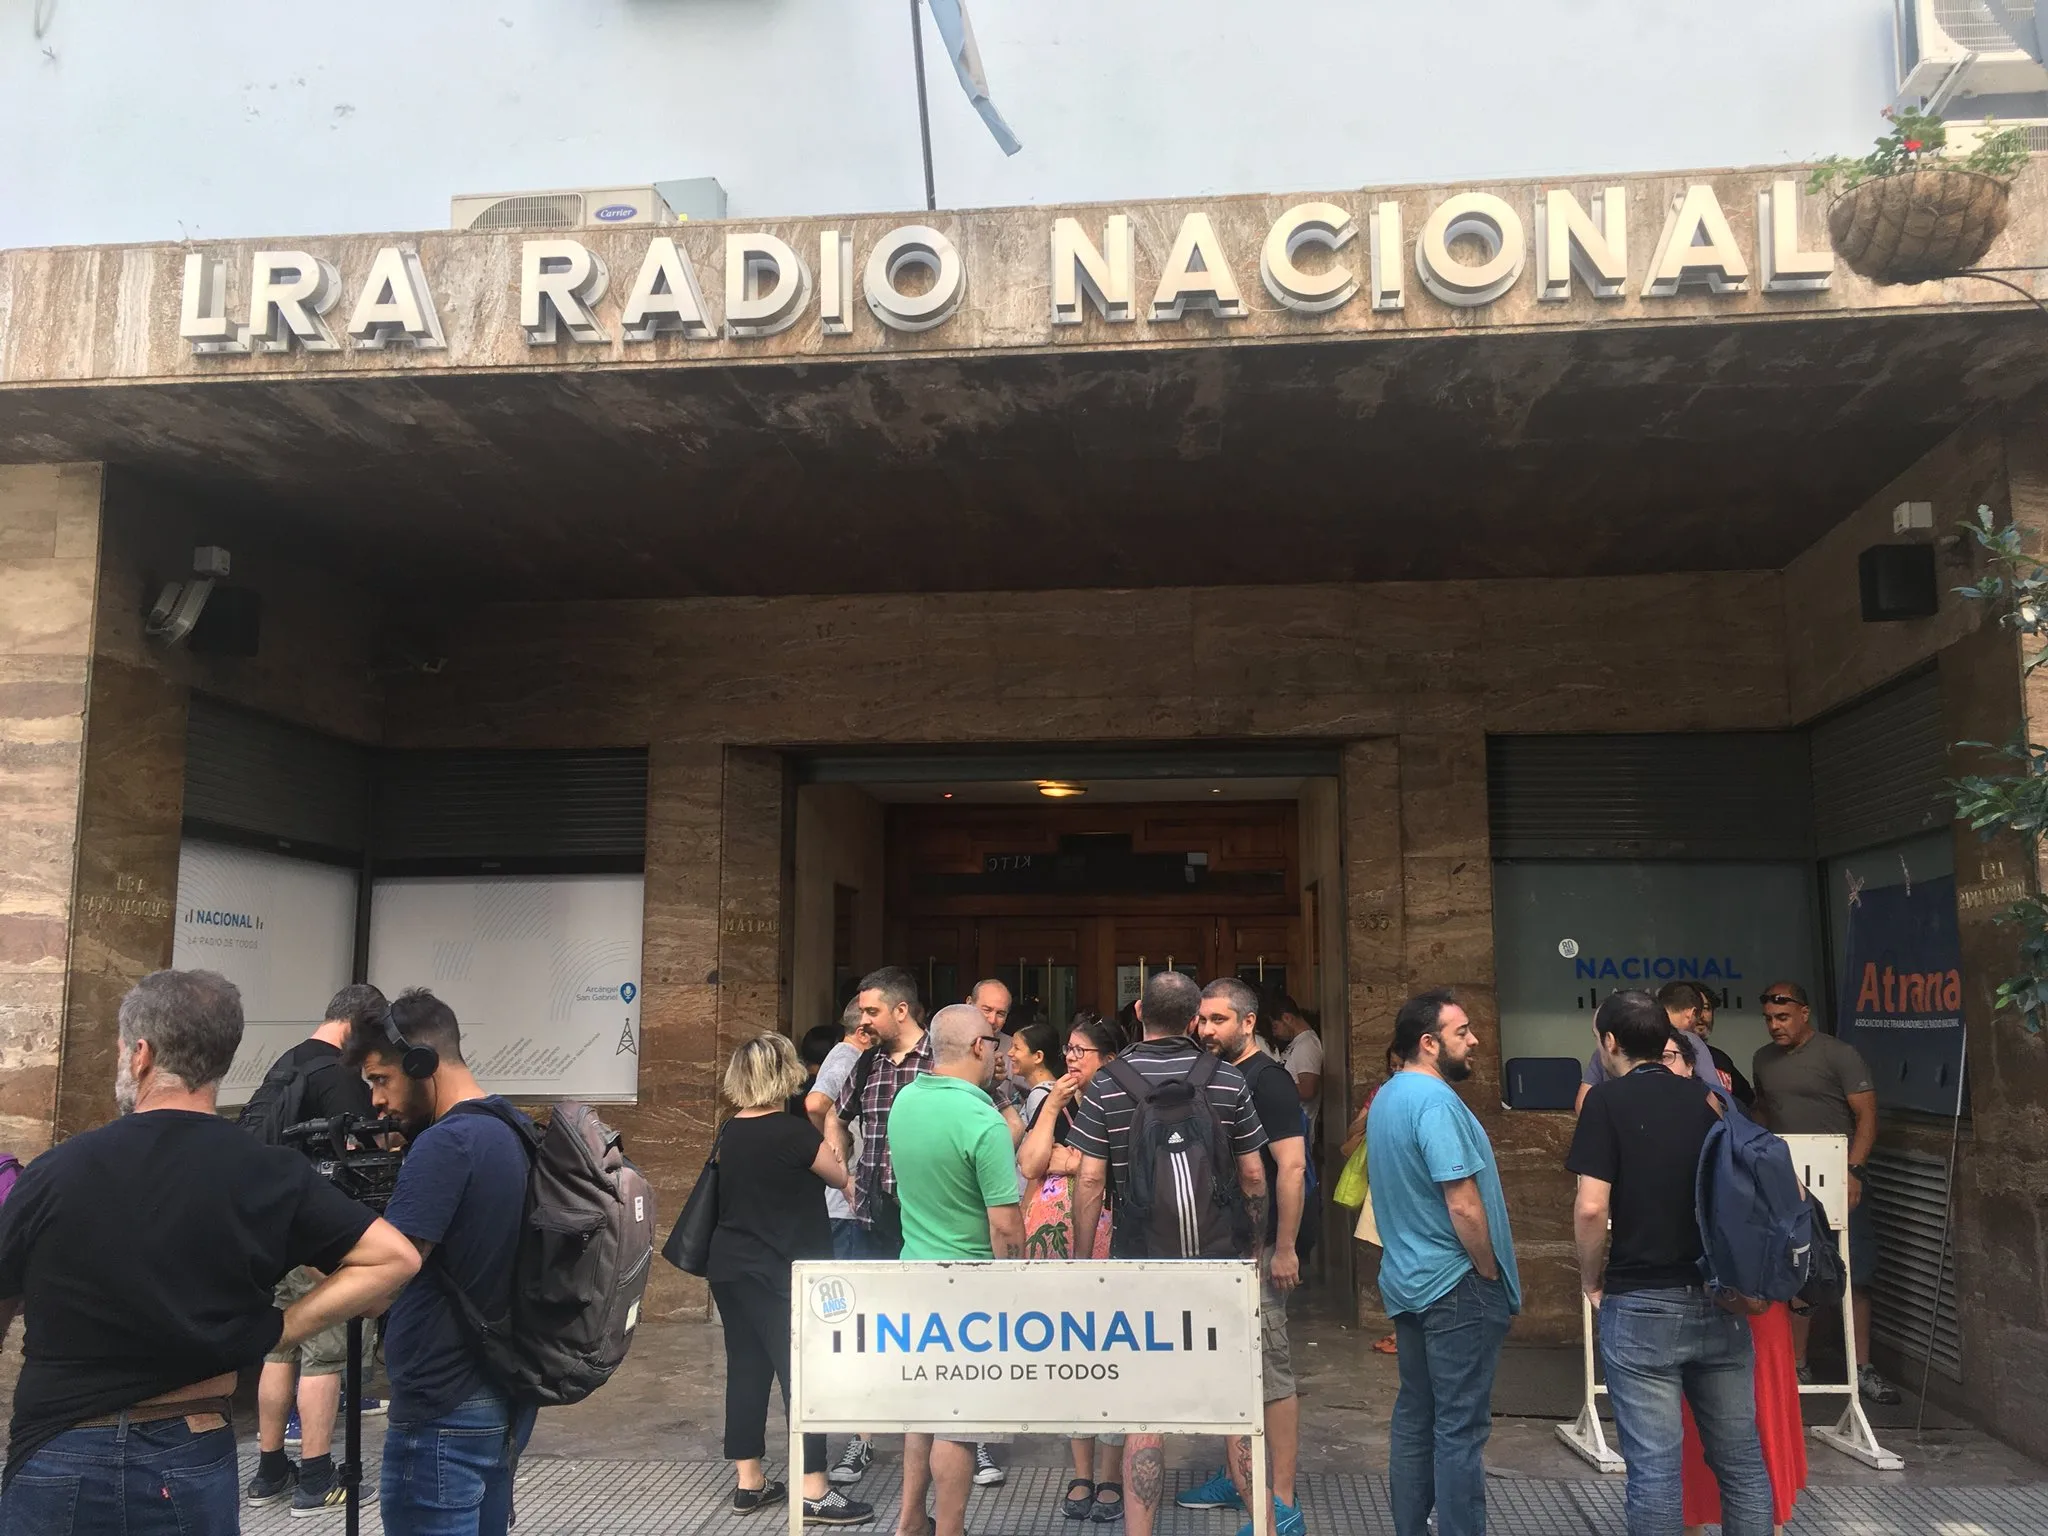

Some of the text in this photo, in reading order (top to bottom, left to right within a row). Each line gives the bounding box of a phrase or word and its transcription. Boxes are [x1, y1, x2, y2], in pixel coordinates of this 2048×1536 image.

[600, 208, 633, 218] Carrier
[179, 181, 1836, 353] LRA RADIO NACIONAL
[196, 910, 253, 929] NACIONAL
[199, 936, 223, 946] RADIO
[223, 938, 233, 948] DE
[235, 939, 258, 950] TODOS
[1575, 957, 1743, 980] NACIONAL
[1856, 961, 1961, 1013] Atrana
[876, 1310, 1174, 1353] NACIONAL
[901, 1363, 1120, 1382] LA RADIO DE TODOS
